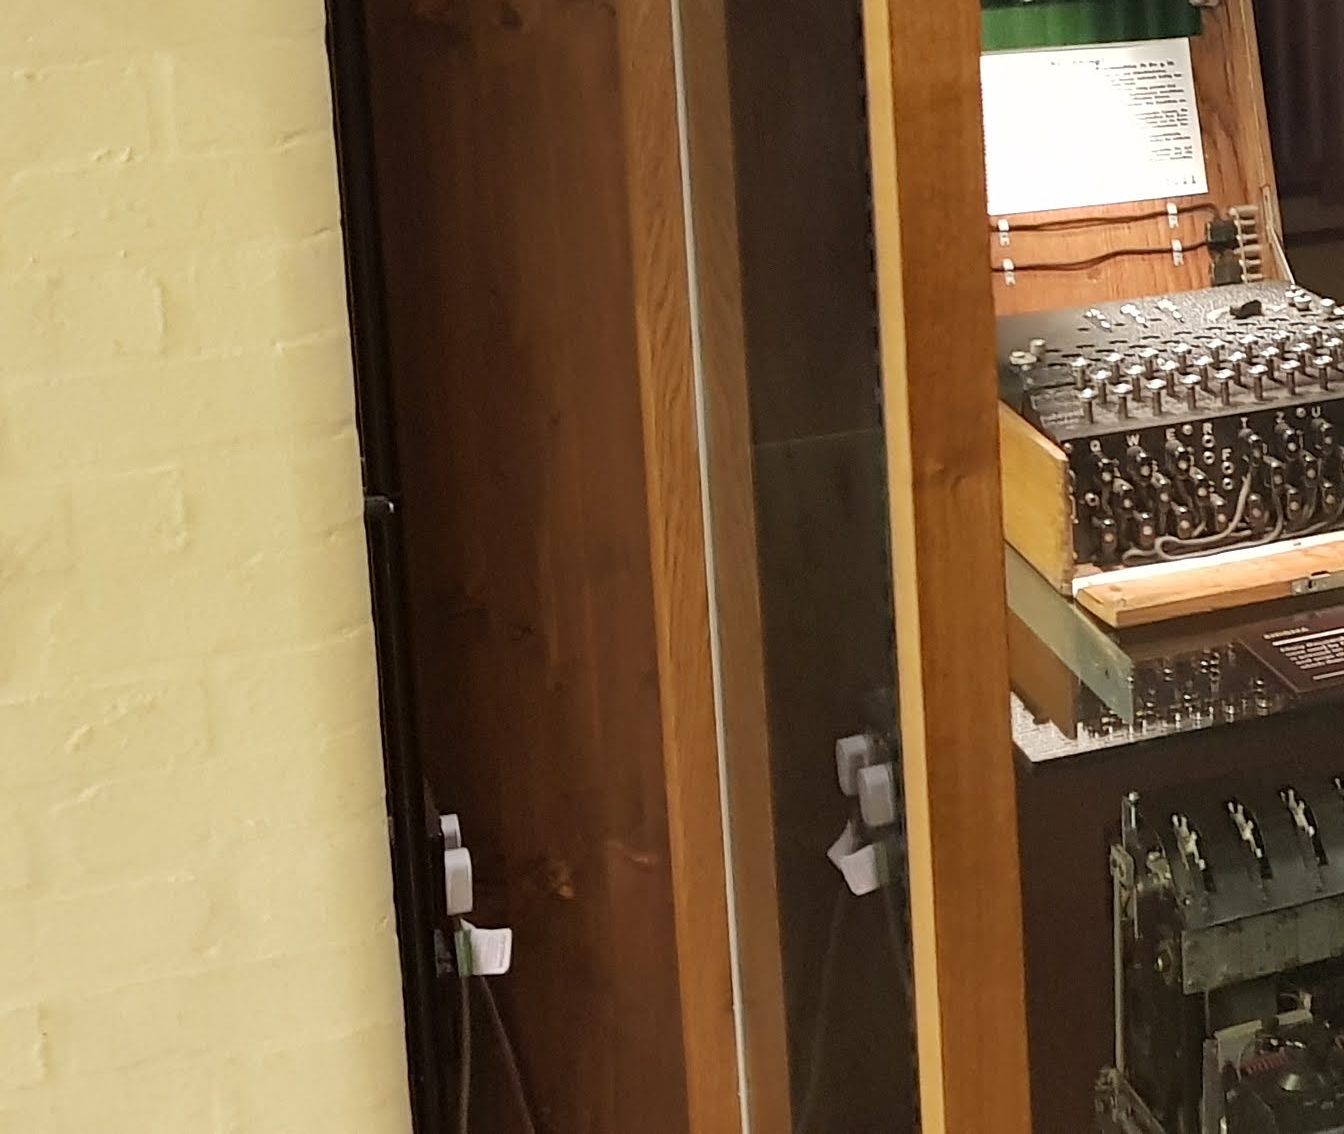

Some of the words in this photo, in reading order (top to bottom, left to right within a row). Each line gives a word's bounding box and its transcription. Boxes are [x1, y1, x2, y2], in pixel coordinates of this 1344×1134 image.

[1126, 433, 1141, 447] W
[1165, 428, 1177, 441] E
[1203, 422, 1213, 435] R
[1311, 406, 1321, 418] U
[1221, 447, 1232, 461] F
